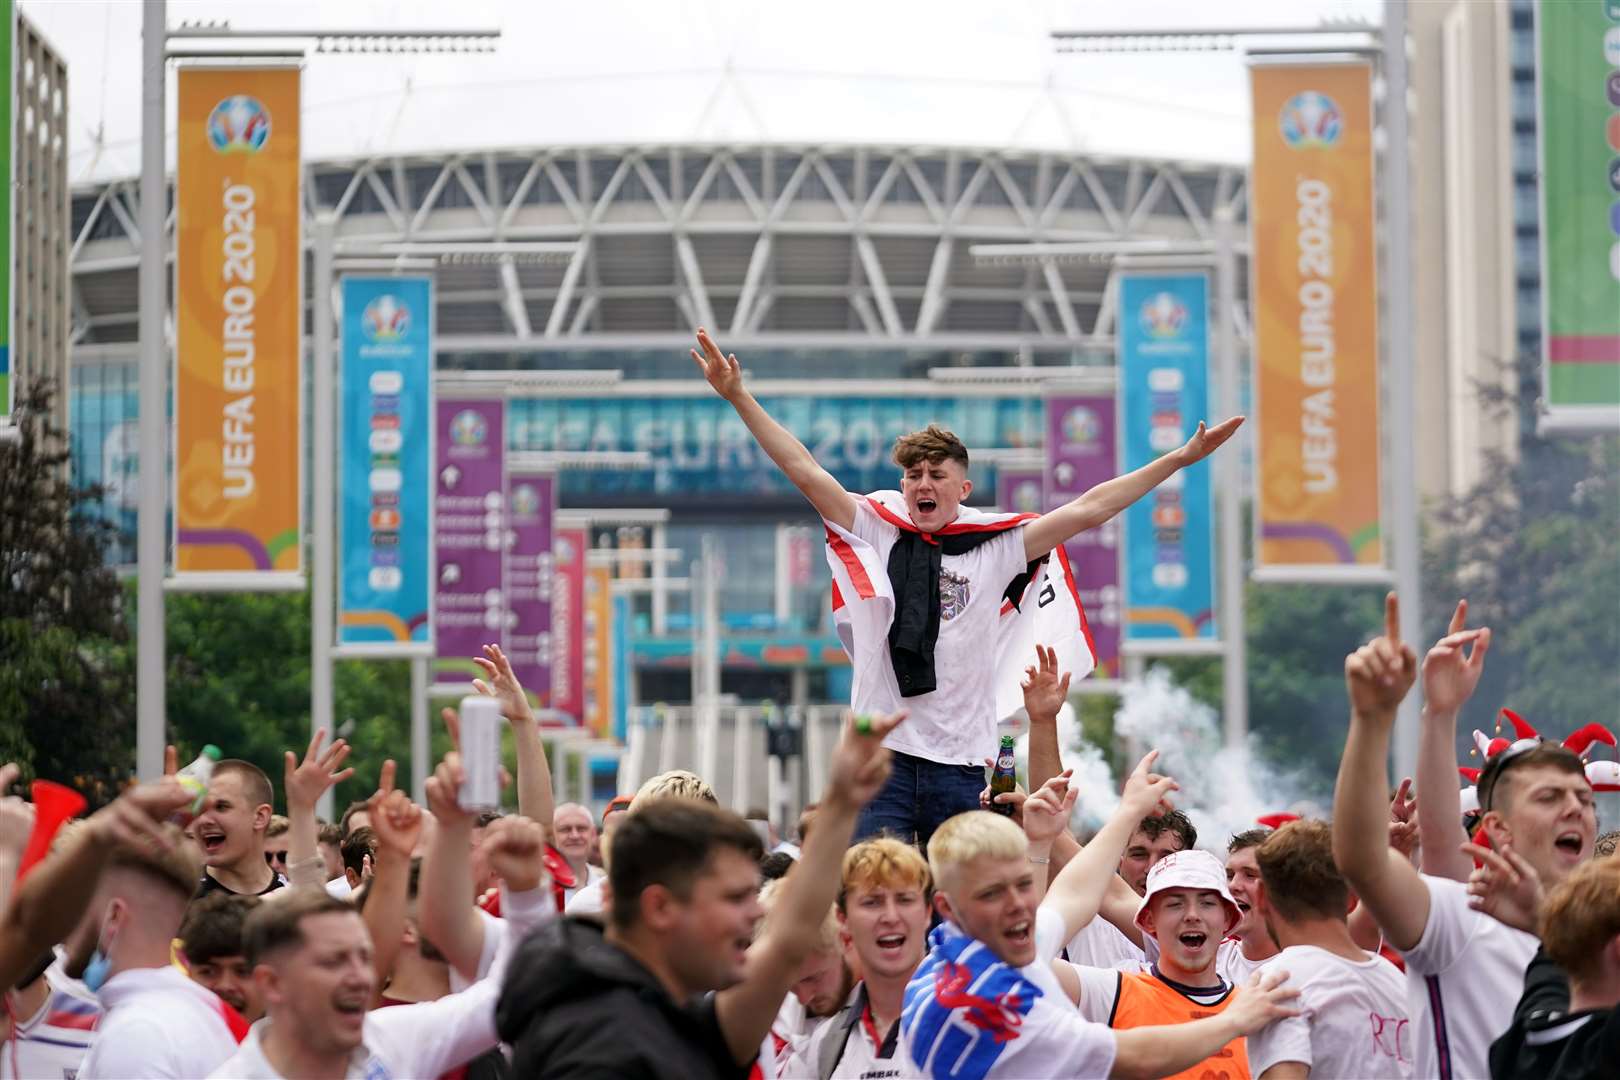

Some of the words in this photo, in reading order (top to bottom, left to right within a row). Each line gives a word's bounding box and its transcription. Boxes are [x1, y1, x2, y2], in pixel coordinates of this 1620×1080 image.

[222, 184, 256, 283] 2020
[1295, 178, 1334, 279] 2020
[222, 286, 256, 393] EURO
[1298, 281, 1336, 387] EURO
[222, 396, 256, 499] UEFA
[1300, 389, 1338, 493] UEFA
